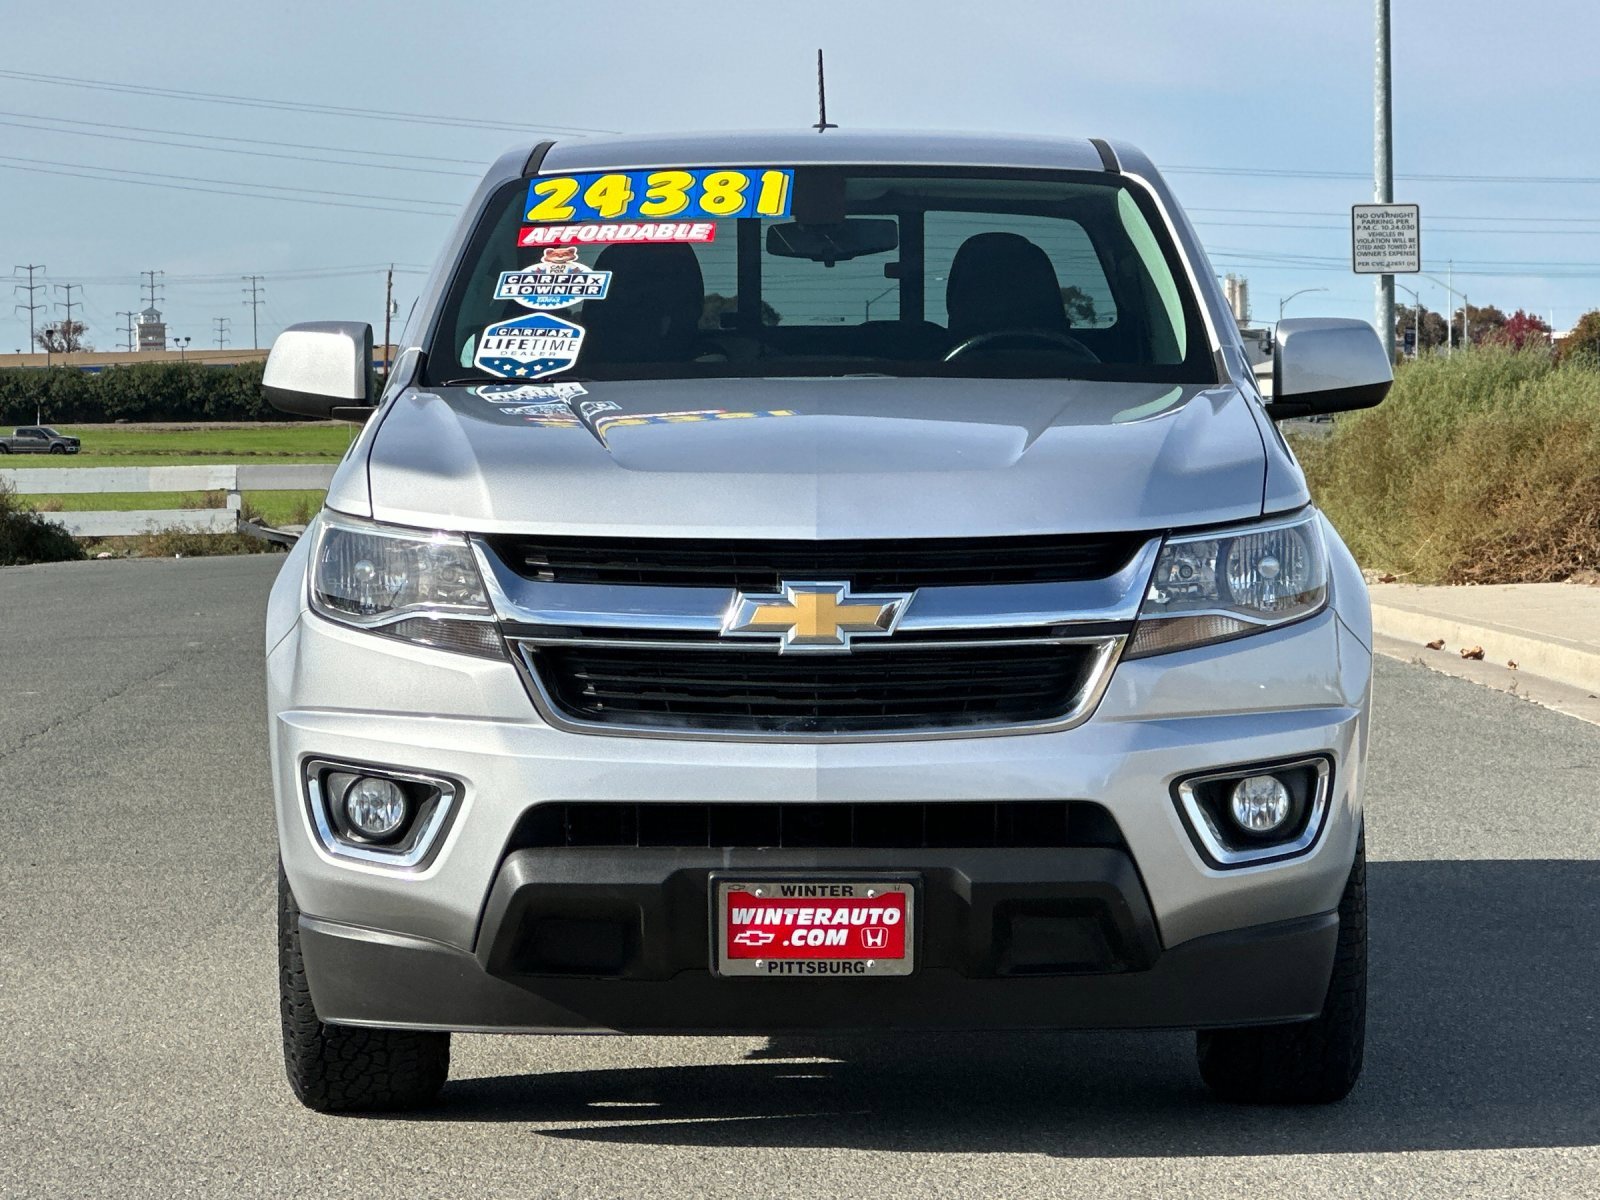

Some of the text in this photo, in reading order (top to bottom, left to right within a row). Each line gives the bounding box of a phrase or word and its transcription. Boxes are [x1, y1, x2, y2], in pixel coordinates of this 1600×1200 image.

[527, 170, 789, 220] 24381
[522, 224, 709, 243] AFFORDABLE
[508, 276, 602, 284] CARFAX
[520, 286, 599, 294] OWNER
[498, 329, 571, 338] CARFAX
[484, 338, 578, 351] LIFETIME
[781, 886, 853, 896] WINTER
[732, 908, 901, 925] WINTERAUTO
[782, 929, 848, 946] .COM
[768, 961, 865, 974] PITTSBURG
